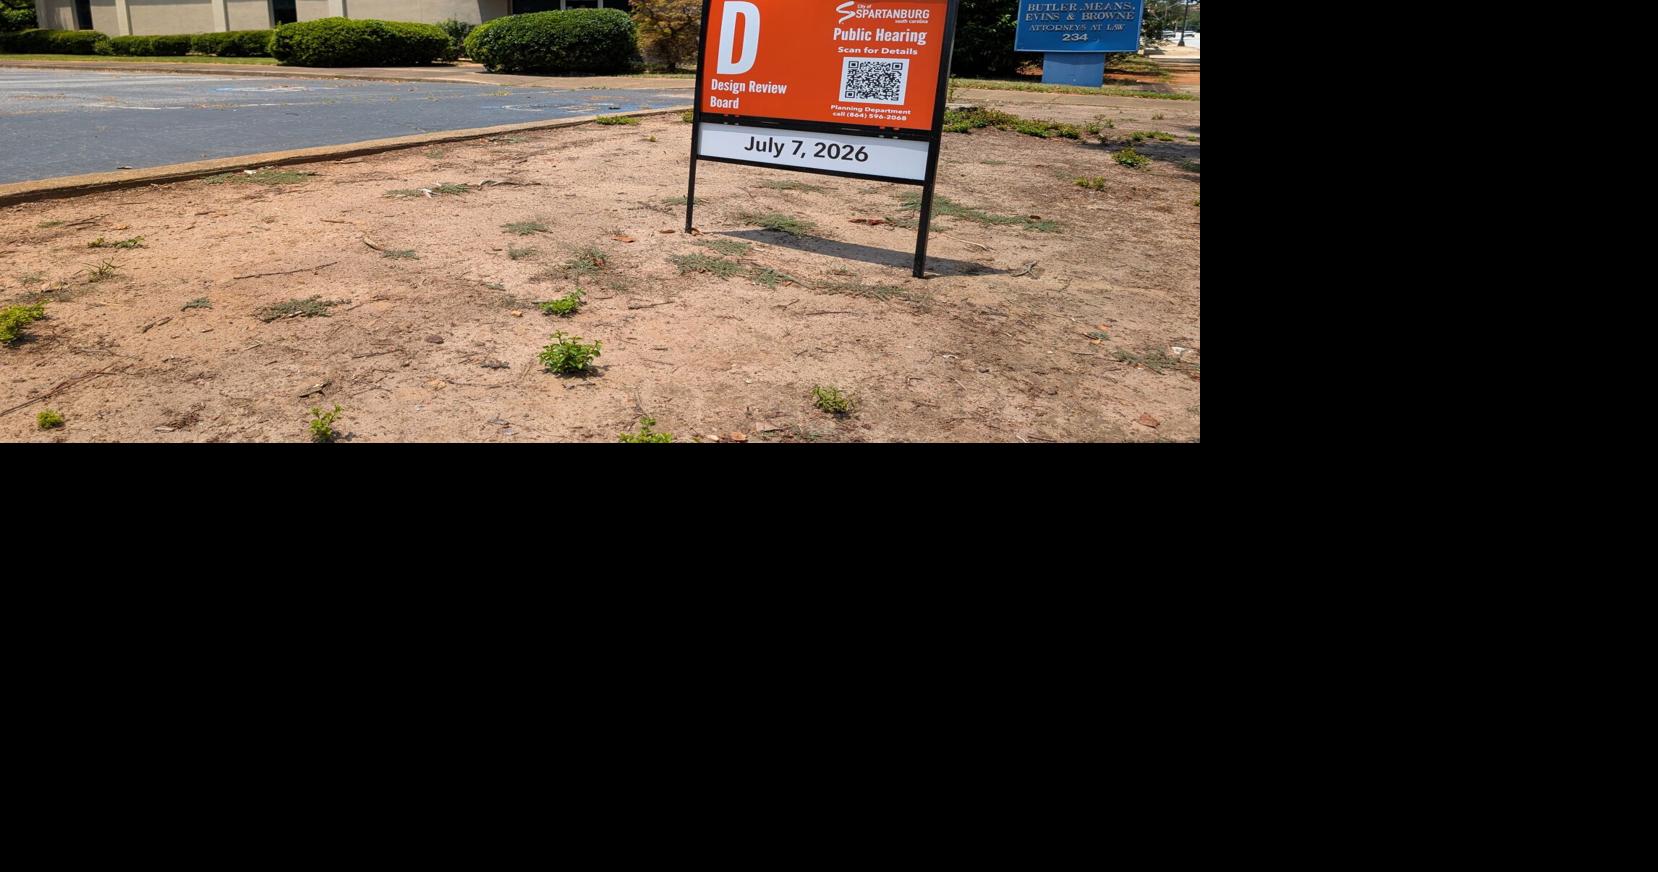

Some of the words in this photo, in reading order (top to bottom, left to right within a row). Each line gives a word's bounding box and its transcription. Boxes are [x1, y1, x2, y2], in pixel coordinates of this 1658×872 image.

[855, 9, 930, 19] SPARTANBURG
[1025, 12, 1061, 21] EVINS
[1066, 13, 1076, 21] &
[1081, 11, 1136, 20] BROWNE
[1106, 23, 1126, 31] LAW
[717, 0, 761, 75] D
[833, 27, 872, 41] Public
[875, 28, 927, 45] Hearing
[1062, 33, 1089, 42] 234
[837, 46, 861, 54] Scan
[863, 46, 879, 54] for
[881, 47, 919, 56] Details
[710, 78, 747, 96] Design
[748, 80, 788, 95] Review
[709, 95, 740, 110] Board
[830, 104, 863, 112] Planning
[864, 106, 911, 114] Department
[868, 113, 908, 121] 596-2068
[743, 136, 785, 158] July
[791, 140, 806, 159] 7,
[813, 141, 870, 163] 2026
